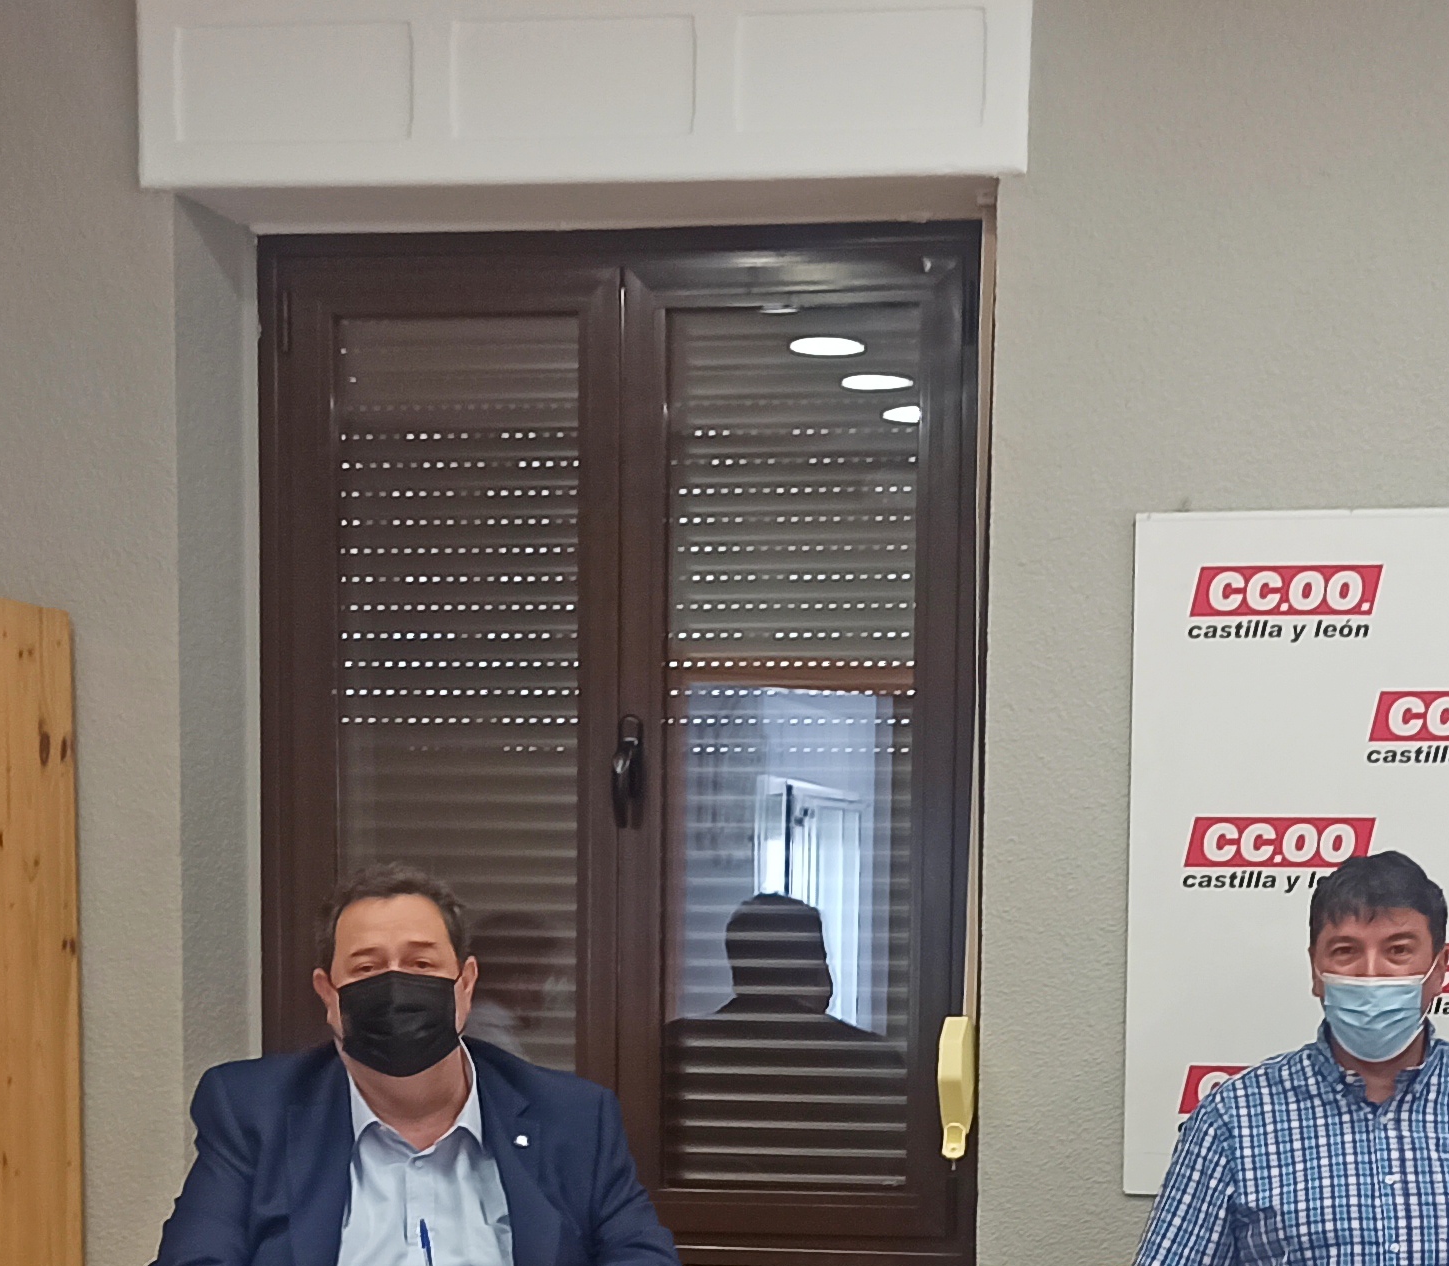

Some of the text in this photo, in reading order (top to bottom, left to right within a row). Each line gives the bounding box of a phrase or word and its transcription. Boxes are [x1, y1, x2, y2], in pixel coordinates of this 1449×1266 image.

[1209, 571, 1371, 612] CC.OO.
[1188, 620, 1369, 642] castilla y león
[1204, 823, 1355, 863] CC.OO
[1183, 871, 1276, 888] castilla
[1285, 876, 1300, 893] y
